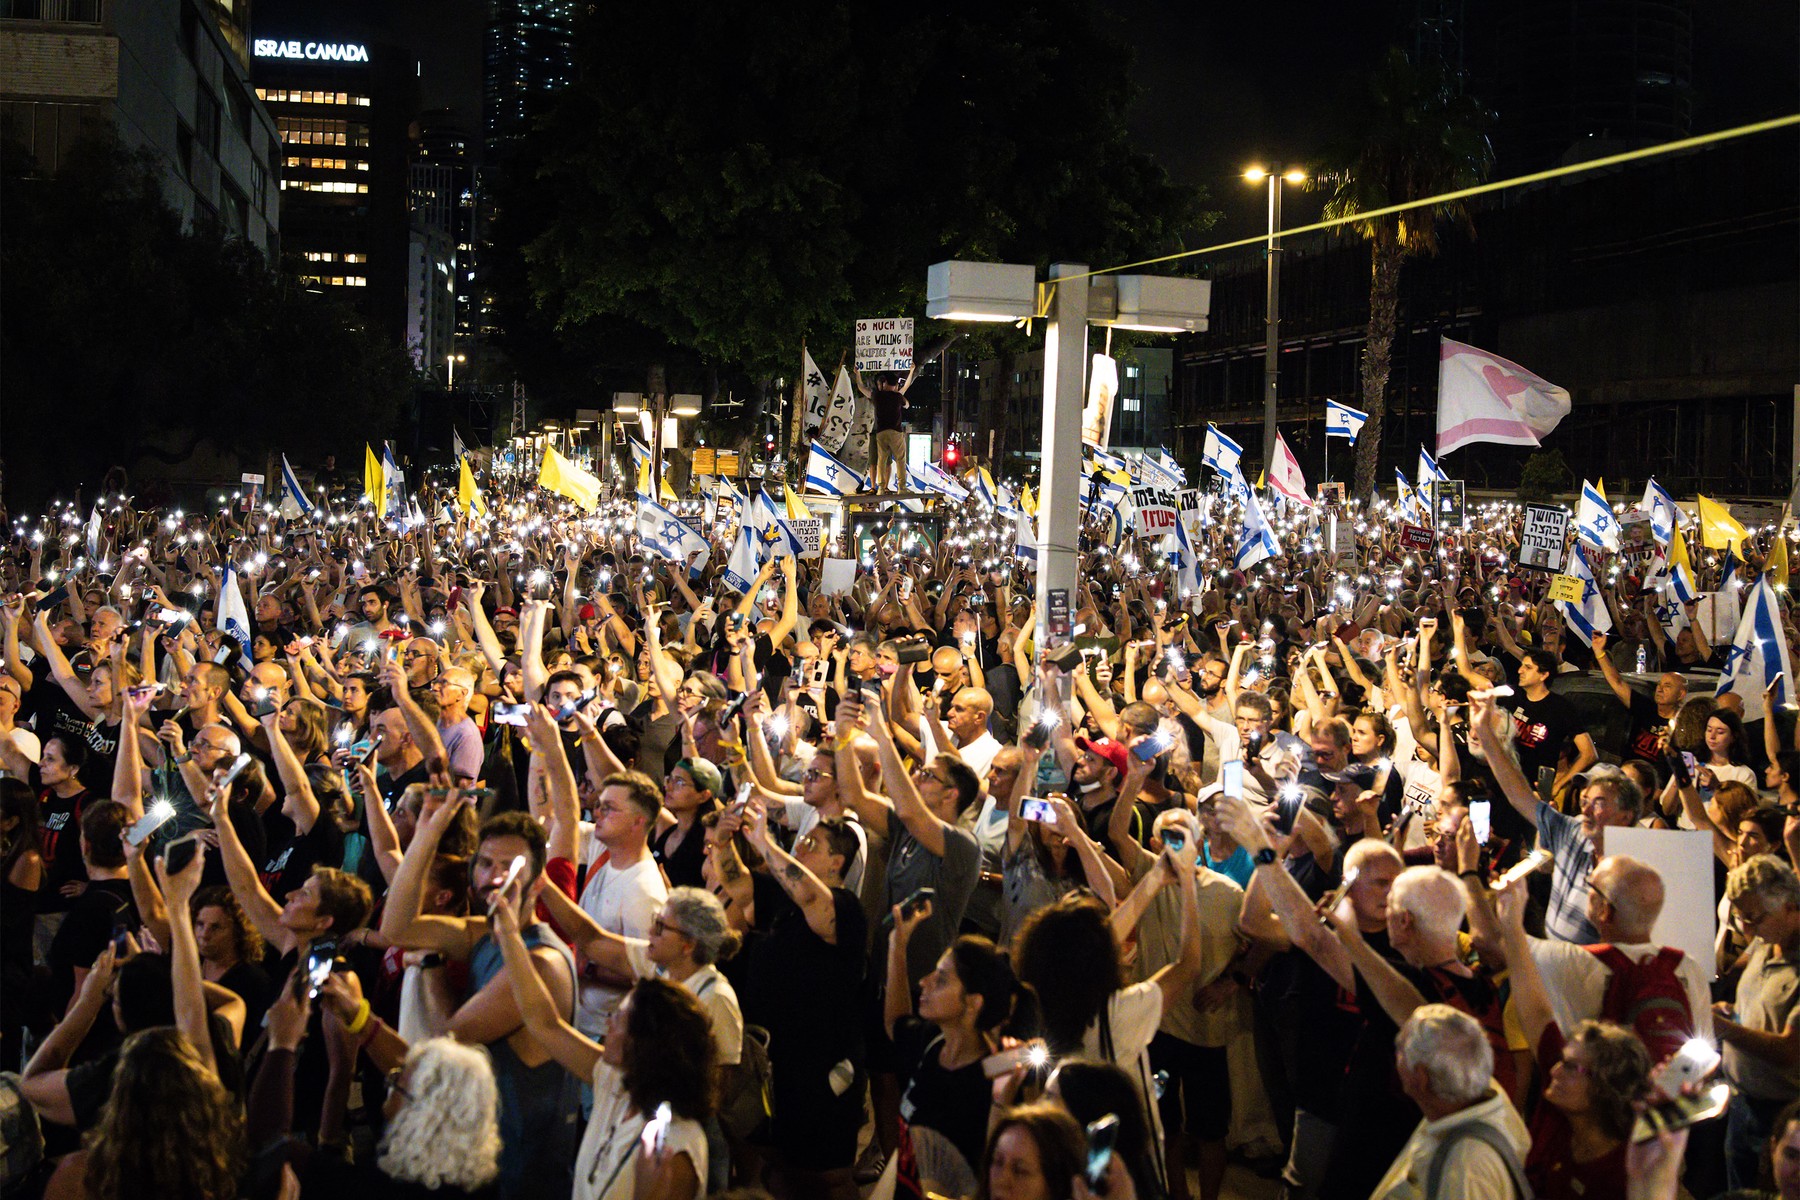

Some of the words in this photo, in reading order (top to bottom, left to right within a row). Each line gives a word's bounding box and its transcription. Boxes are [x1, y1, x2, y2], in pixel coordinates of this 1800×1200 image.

[254, 39, 305, 58] ISRAEL
[305, 42, 369, 62] CANADA
[857, 322, 867, 332] SO
[873, 321, 895, 331] MUCH
[900, 320, 913, 330] WE
[857, 335, 871, 346] ARE
[905, 333, 914, 345] TO
[890, 346, 897, 357] 4
[899, 347, 913, 357] WAR
[856, 361, 864, 370] SO
[866, 360, 882, 370] LITTLE
[884, 357, 892, 369] 4
[894, 358, 912, 370] PEACE
[1181, 491, 1199, 511] את
[1529, 508, 1564, 526] החושך
[1530, 523, 1561, 537] בקצה
[1523, 534, 1562, 550] המנהרה
